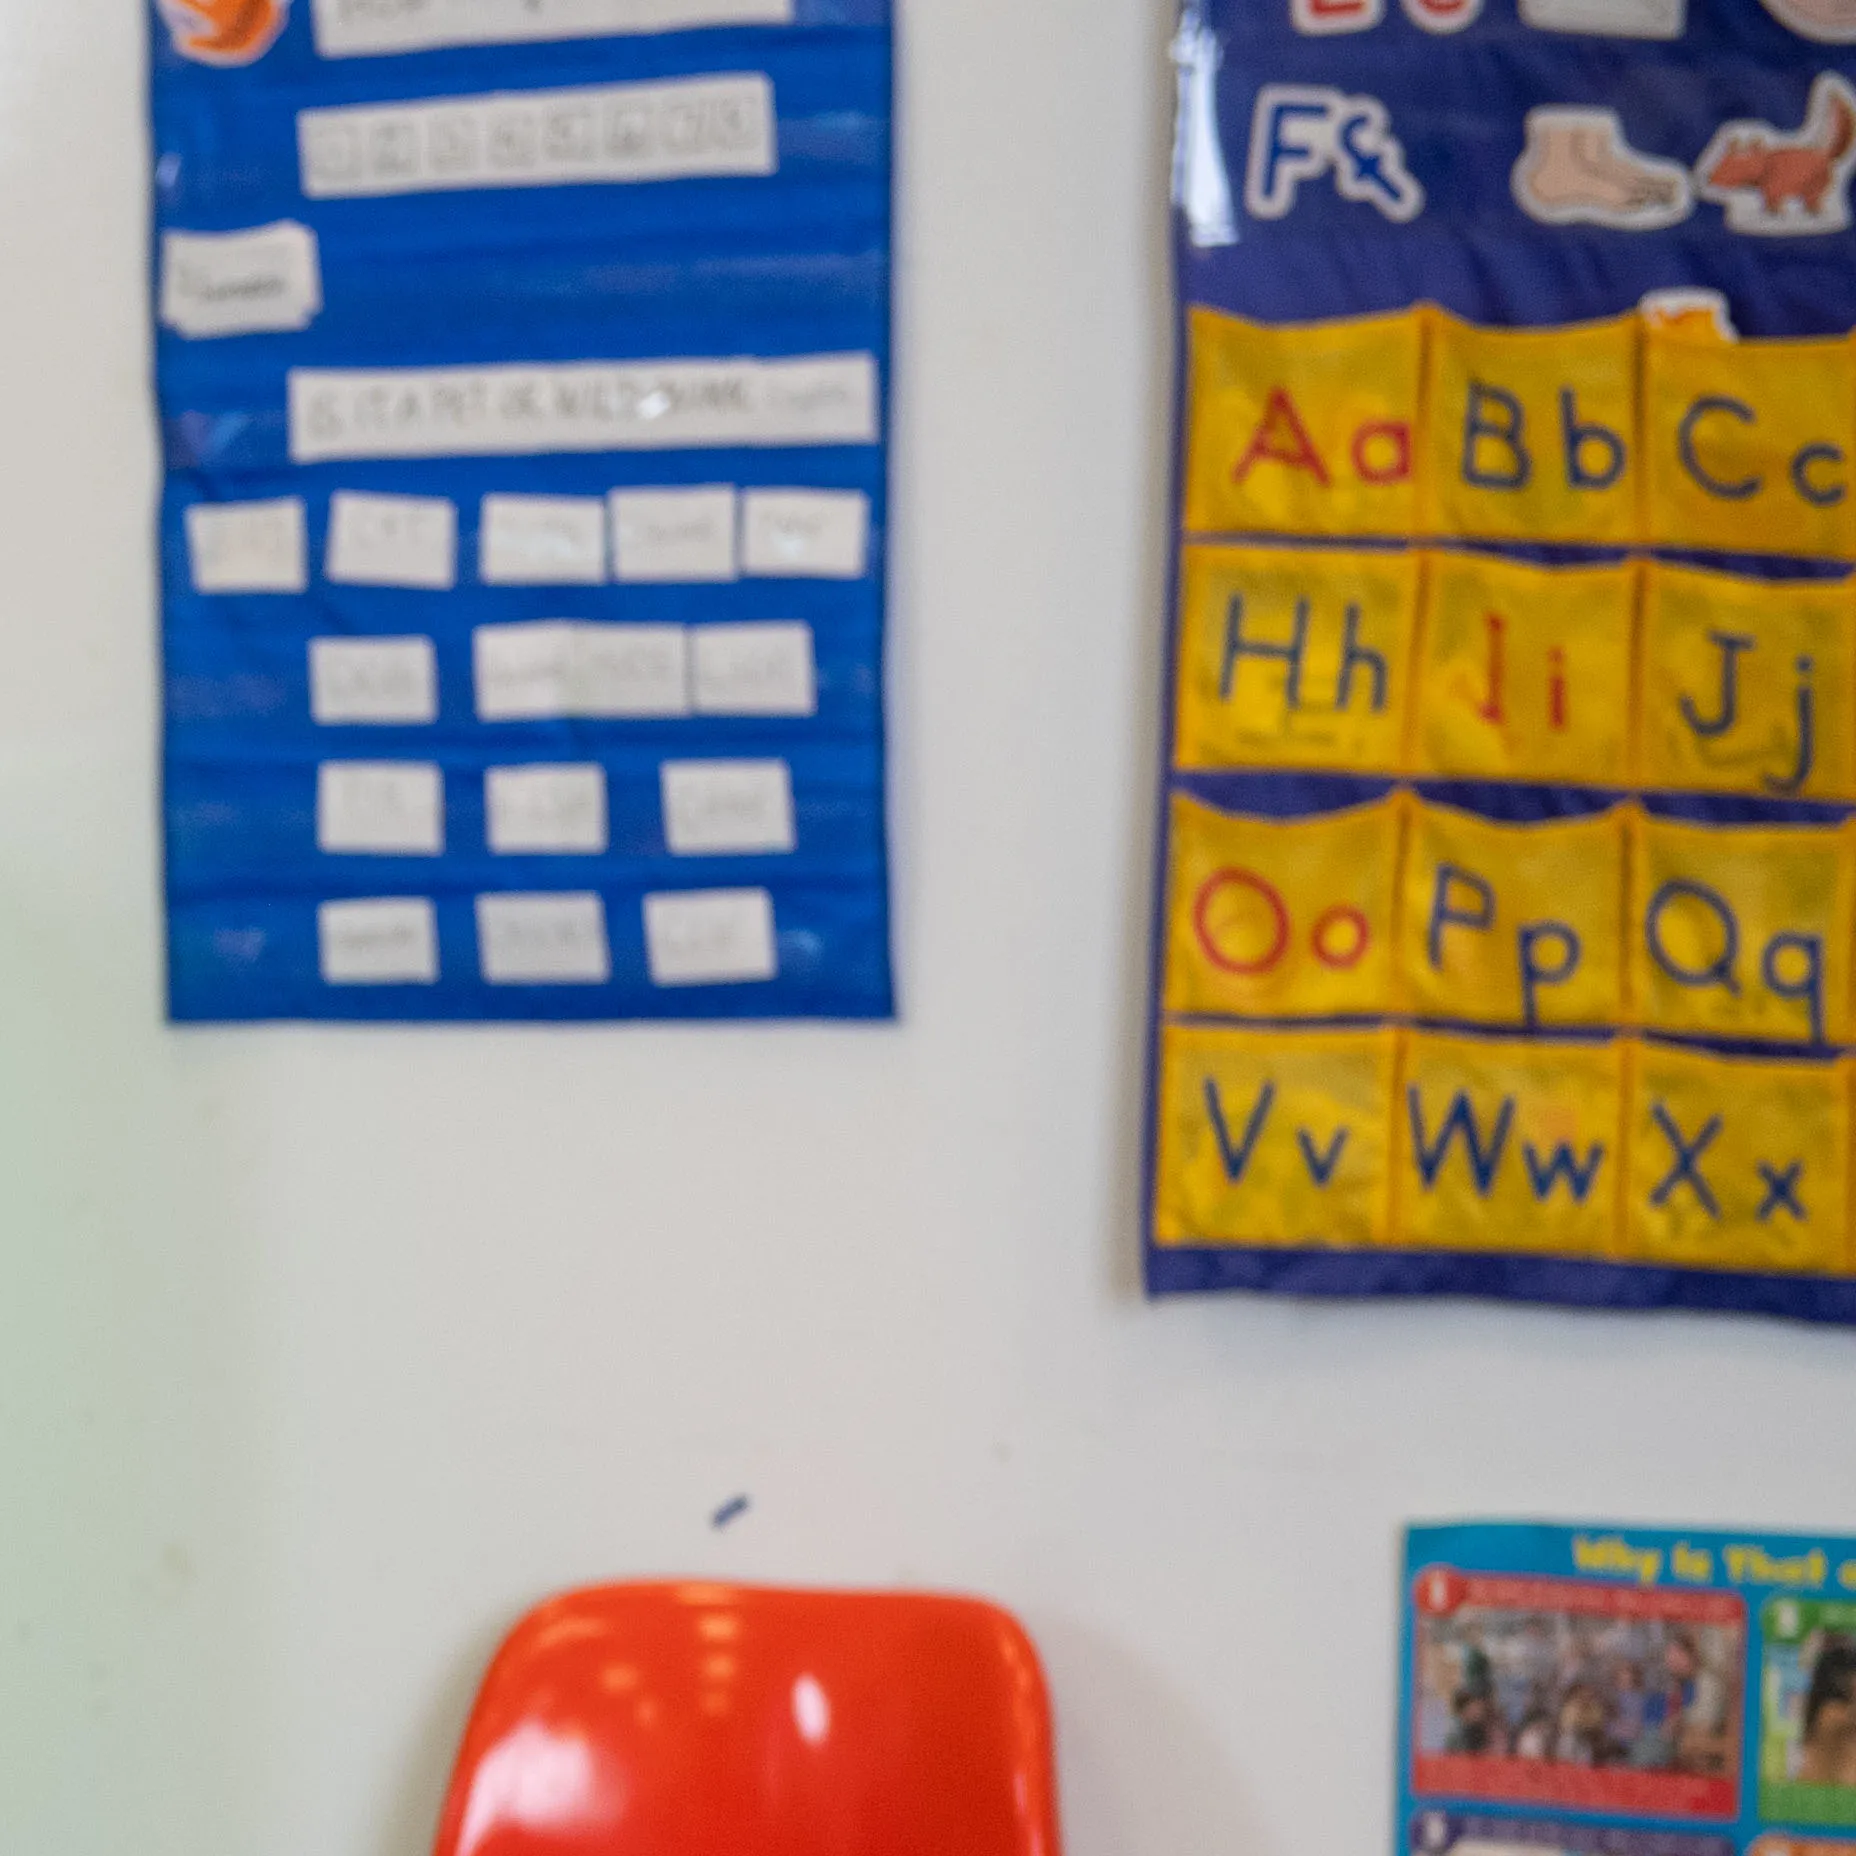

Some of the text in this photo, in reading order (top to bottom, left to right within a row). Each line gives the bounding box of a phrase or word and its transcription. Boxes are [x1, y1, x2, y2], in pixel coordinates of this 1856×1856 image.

[1232, 383, 1850, 505] Aa Bb Cc
[1217, 594, 1389, 712] Hh
[1679, 631, 1817, 794] Jj
[1191, 860, 1825, 1044] Oo Pp Qq
[1202, 1076, 1806, 1222] Vv Ww Xx
